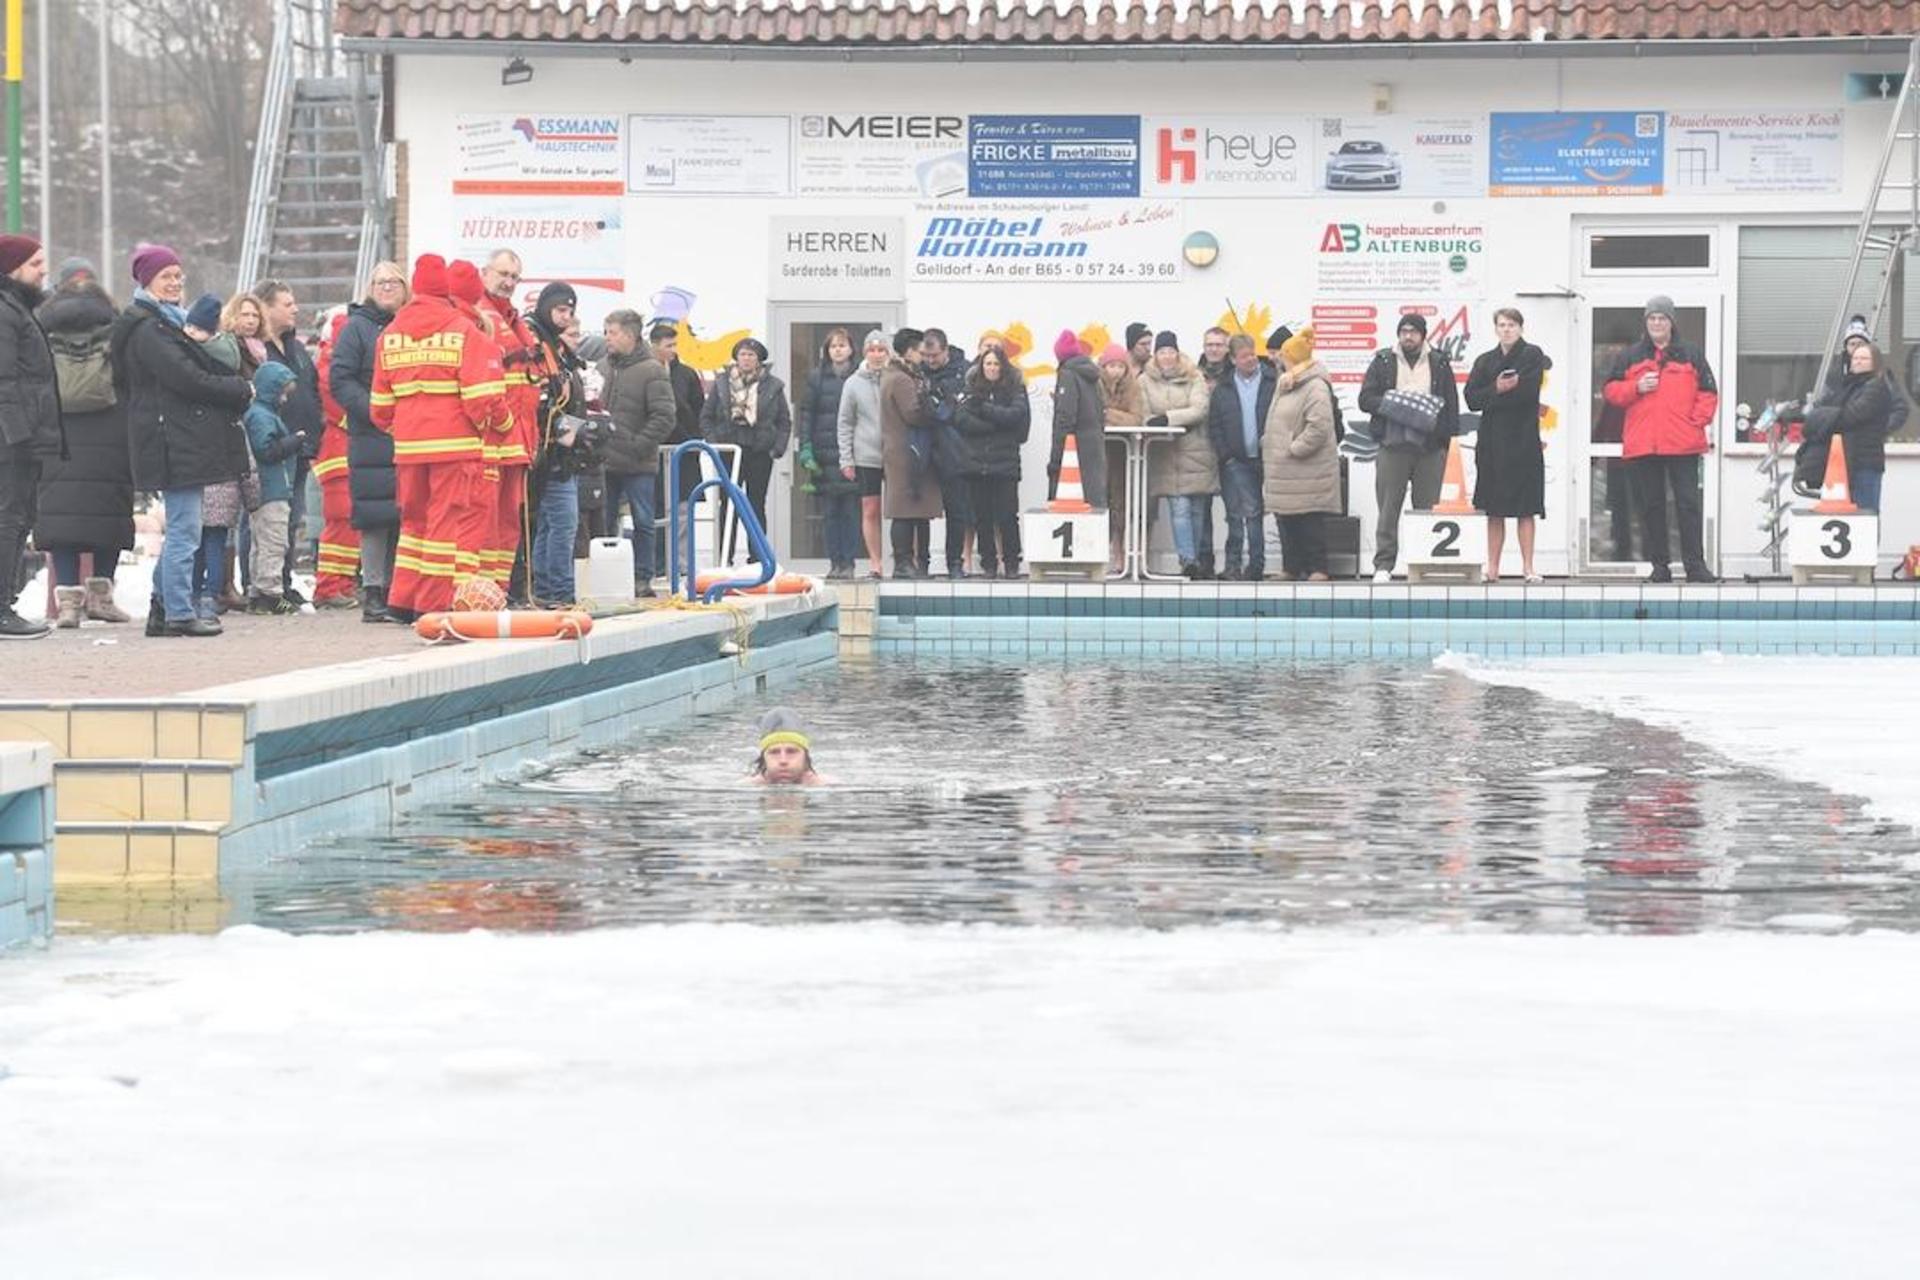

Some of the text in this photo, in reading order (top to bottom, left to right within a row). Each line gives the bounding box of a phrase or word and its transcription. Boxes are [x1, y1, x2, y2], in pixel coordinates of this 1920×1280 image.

[537, 118, 619, 134] ESSMANN
[828, 116, 963, 138] MEIER
[1669, 112, 1841, 128] Bauelemente-Service Koch
[535, 141, 616, 152] HAUSTECHNIK
[1205, 127, 1297, 168] heye
[1414, 133, 1473, 146] KAUFFELD
[973, 145, 1133, 161] FRICKE metallbau
[1557, 149, 1657, 158] ELEKTROTECHNIK
[1205, 169, 1297, 182] international
[926, 216, 1043, 237] Möbel
[1059, 219, 1112, 237] Wohnen
[1366, 223, 1483, 239] hagebaucentrum
[786, 231, 887, 252] HERREN
[1365, 239, 1482, 253] ALTENBURG
[782, 263, 892, 278] Garderobe Toiletten
[985, 263, 1004, 276] An
[1008, 263, 1031, 276] der
[1035, 263, 1063, 276] B65
[1075, 263, 1084, 276] 0
[1088, 263, 1104, 276] 57
[1108, 263, 1125, 276] 24
[1138, 263, 1155, 276] 39
[1158, 263, 1175, 276] 60
[1052, 520, 1074, 559] 1
[1430, 519, 1462, 558] 2
[1820, 518, 1852, 560] 3
